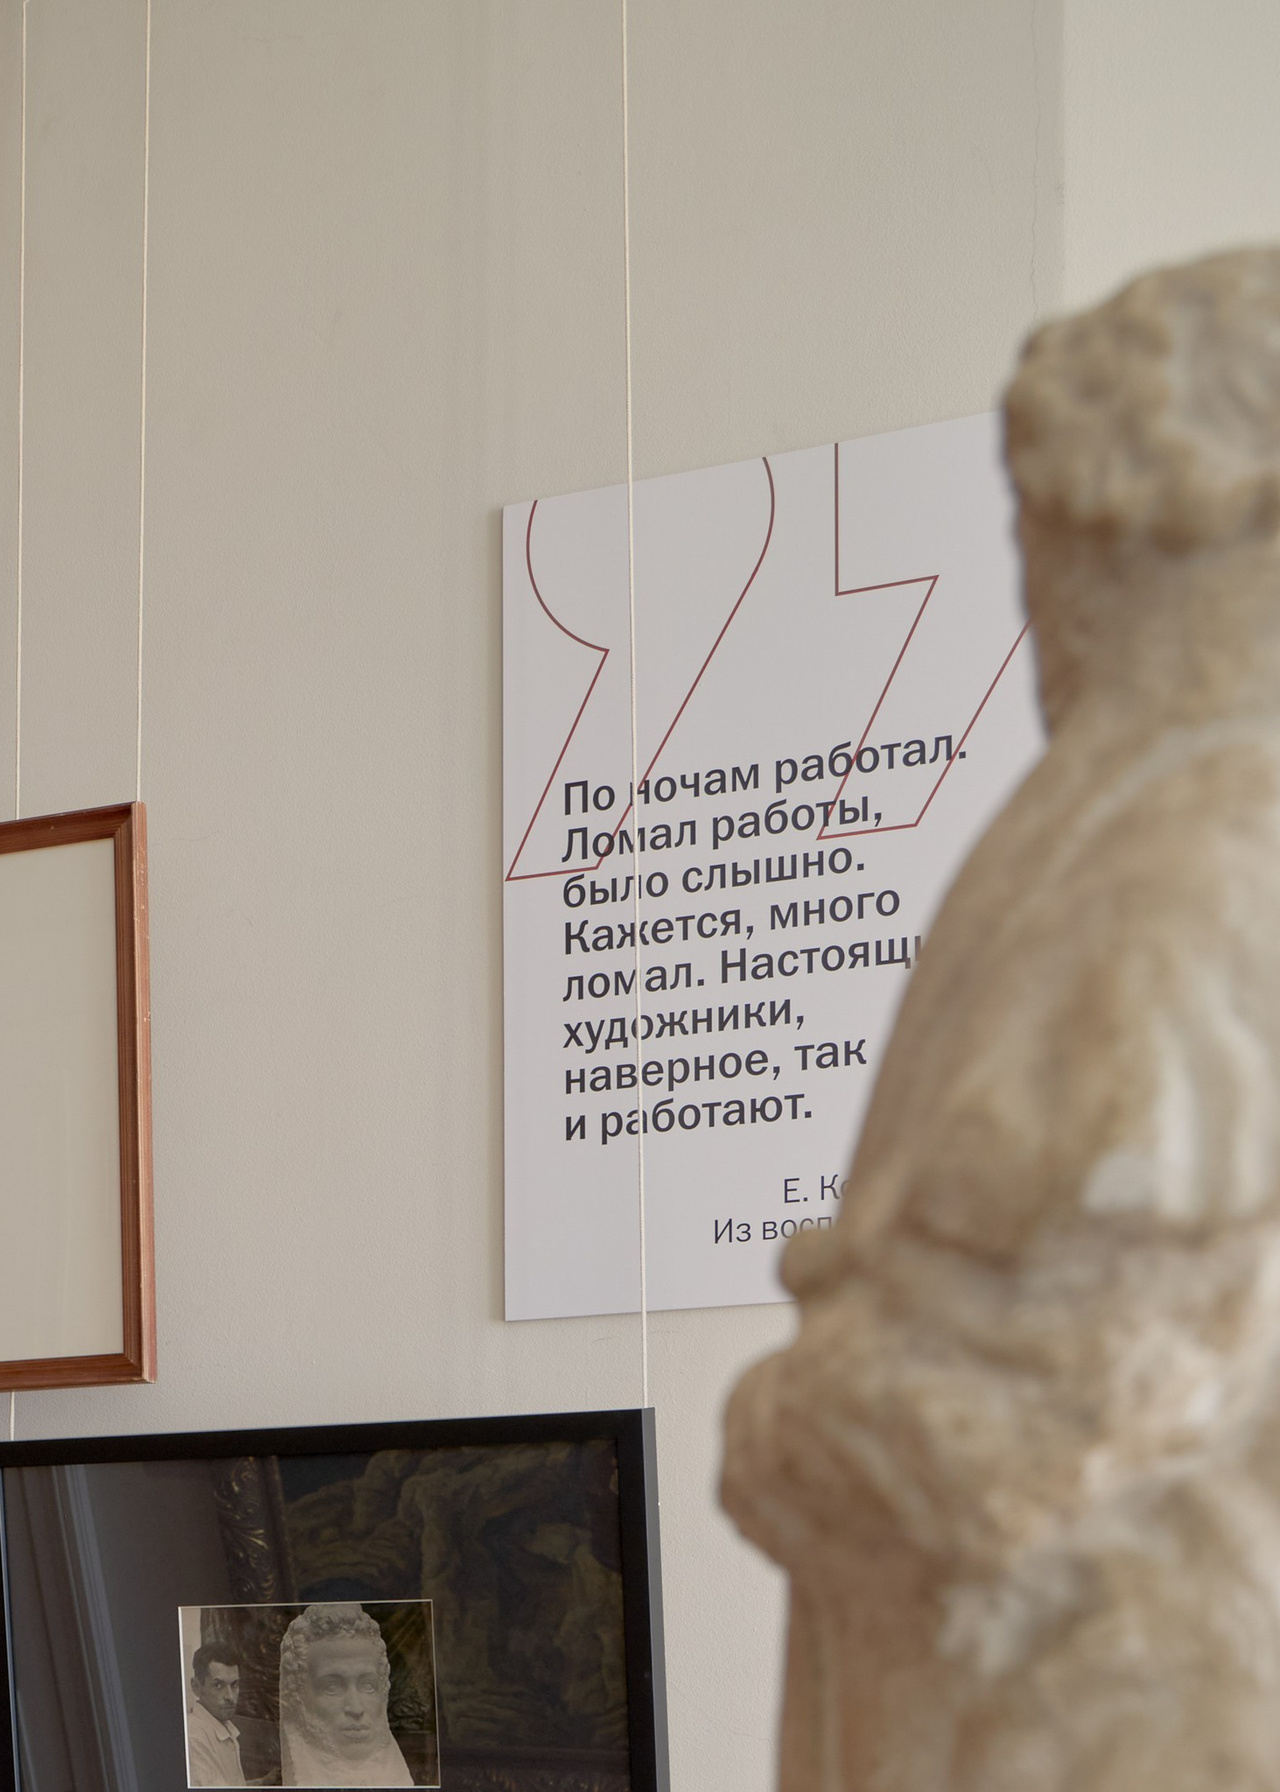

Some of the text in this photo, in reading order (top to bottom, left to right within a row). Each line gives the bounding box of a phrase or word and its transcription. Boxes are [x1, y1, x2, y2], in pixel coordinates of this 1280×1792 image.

[564, 781, 616, 816] По
[775, 733, 967, 787] работал.
[561, 796, 882, 863] Ломал работы,
[564, 846, 865, 908] было слышно.
[565, 888, 900, 955] Кажется, много
[563, 961, 705, 1003] ломал.
[563, 1000, 805, 1054] художники,
[565, 1038, 867, 1094] наверное, так
[565, 1094, 813, 1145] и работают.
[784, 1178, 808, 1203] Е.
[714, 1218, 751, 1244] Из
